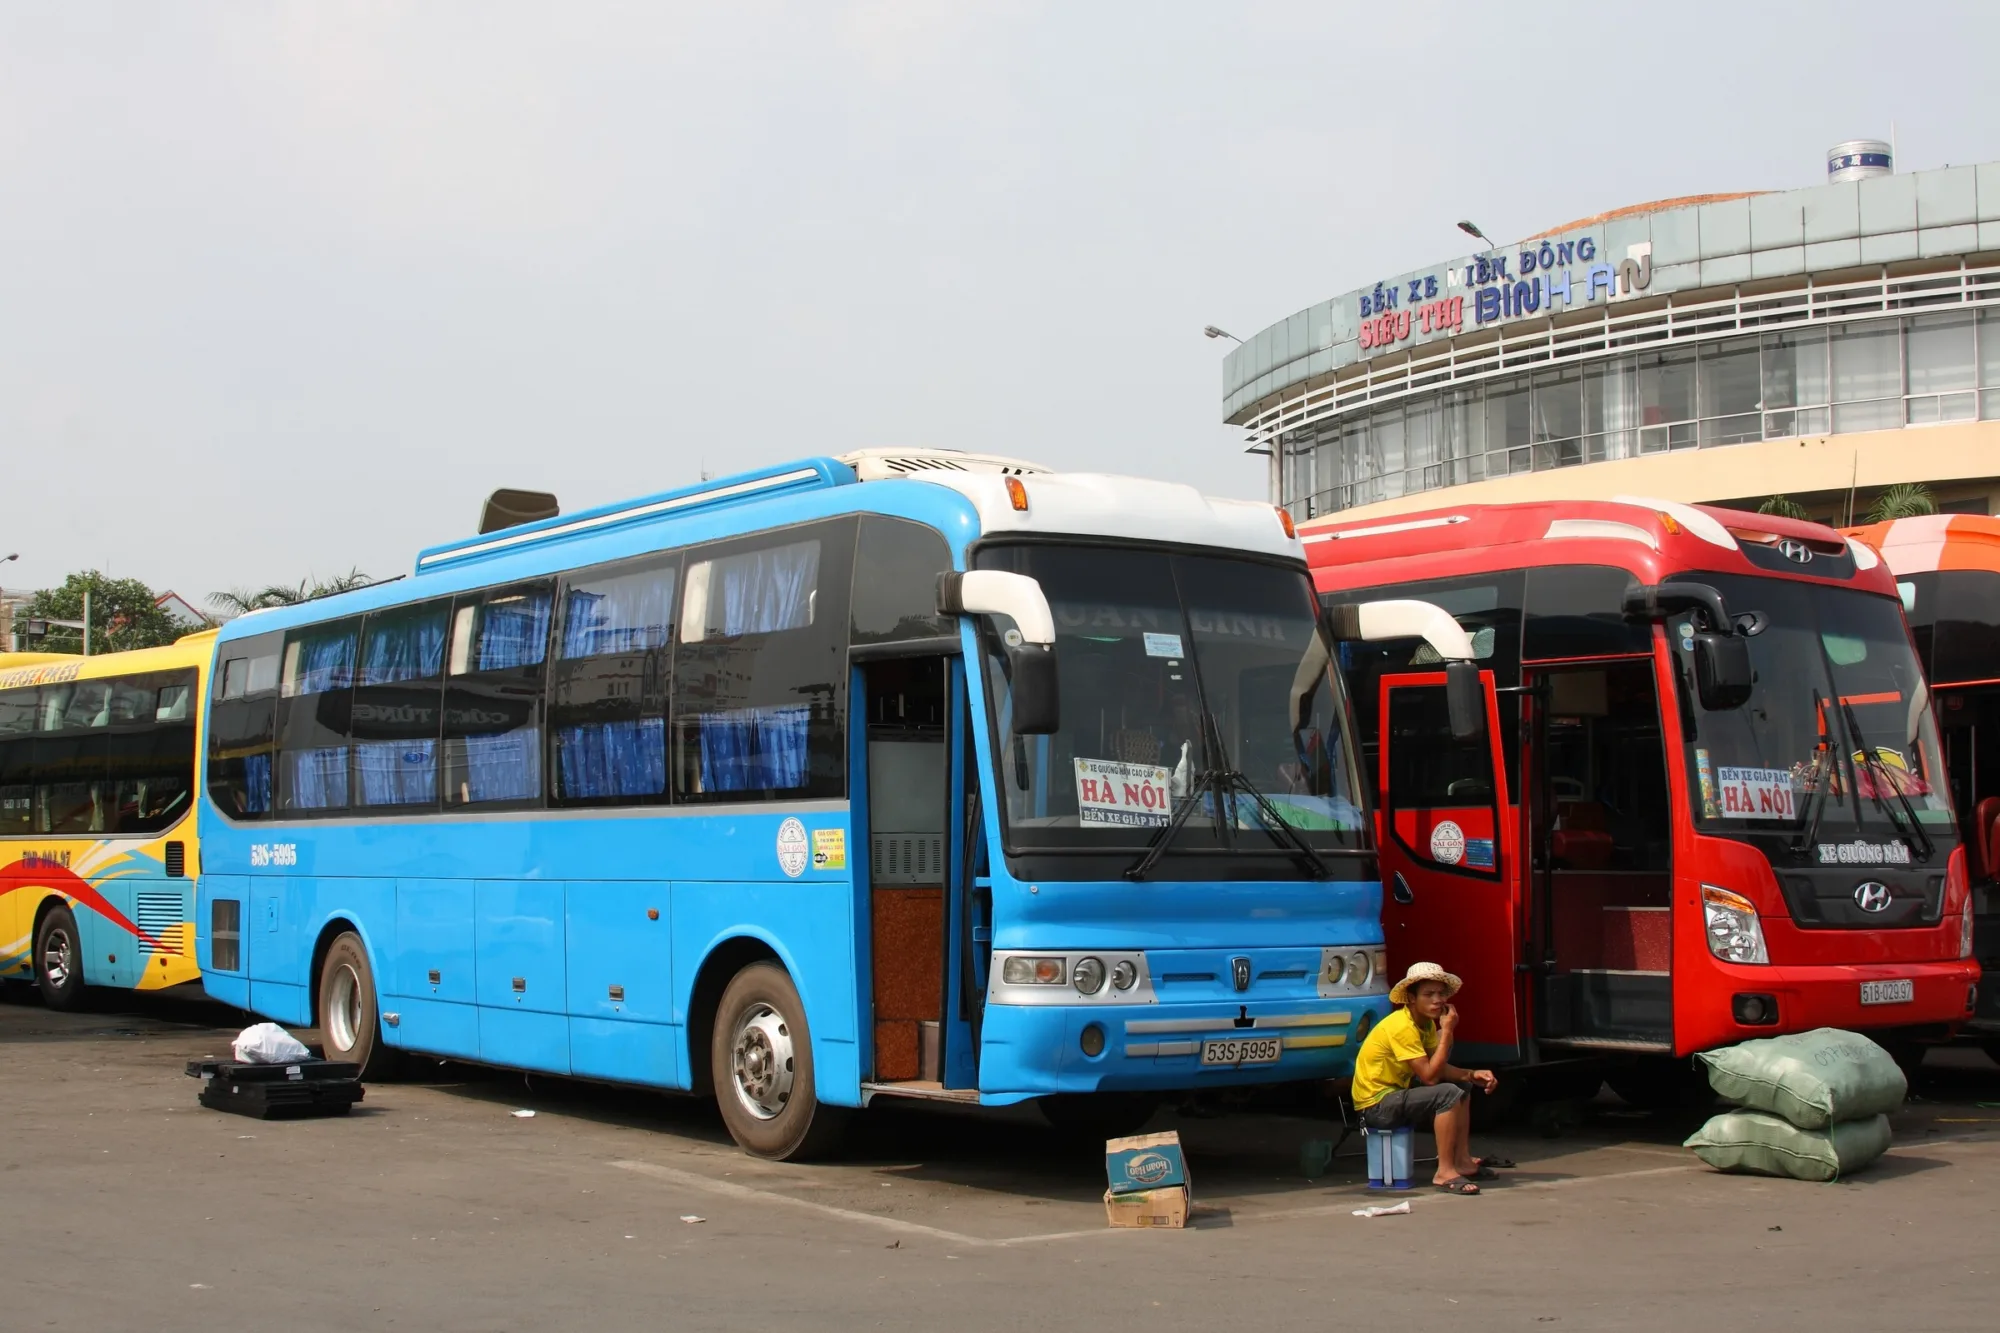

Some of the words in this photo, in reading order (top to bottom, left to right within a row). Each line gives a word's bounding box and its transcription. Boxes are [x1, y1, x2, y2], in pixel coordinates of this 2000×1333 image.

[1359, 281, 1399, 318] BẾN
[1407, 274, 1439, 301] XE
[1519, 237, 1597, 275] ĐÔNG
[1359, 309, 1412, 350] SIÊU
[1416, 295, 1464, 334] THỊ
[1586, 255, 1652, 300] AN
[1090, 764, 1098, 772] XE
[1131, 768, 1142, 778] CAO
[1721, 768, 1739, 781] BẾN
[1741, 770, 1753, 781] XE
[1753, 769, 1772, 782] GIÁP
[1081, 775, 1117, 804] HÀ
[1122, 779, 1167, 812] NỘI
[1723, 781, 1755, 813] HÀ
[1758, 783, 1793, 820] NỘI
[1083, 809, 1105, 821] BẾN
[1107, 813, 1120, 823] XE
[1122, 814, 1146, 826] GIÁP
[1818, 844, 1838, 863] XE
[1863, 982, 1912, 1002] 51B-029.97
